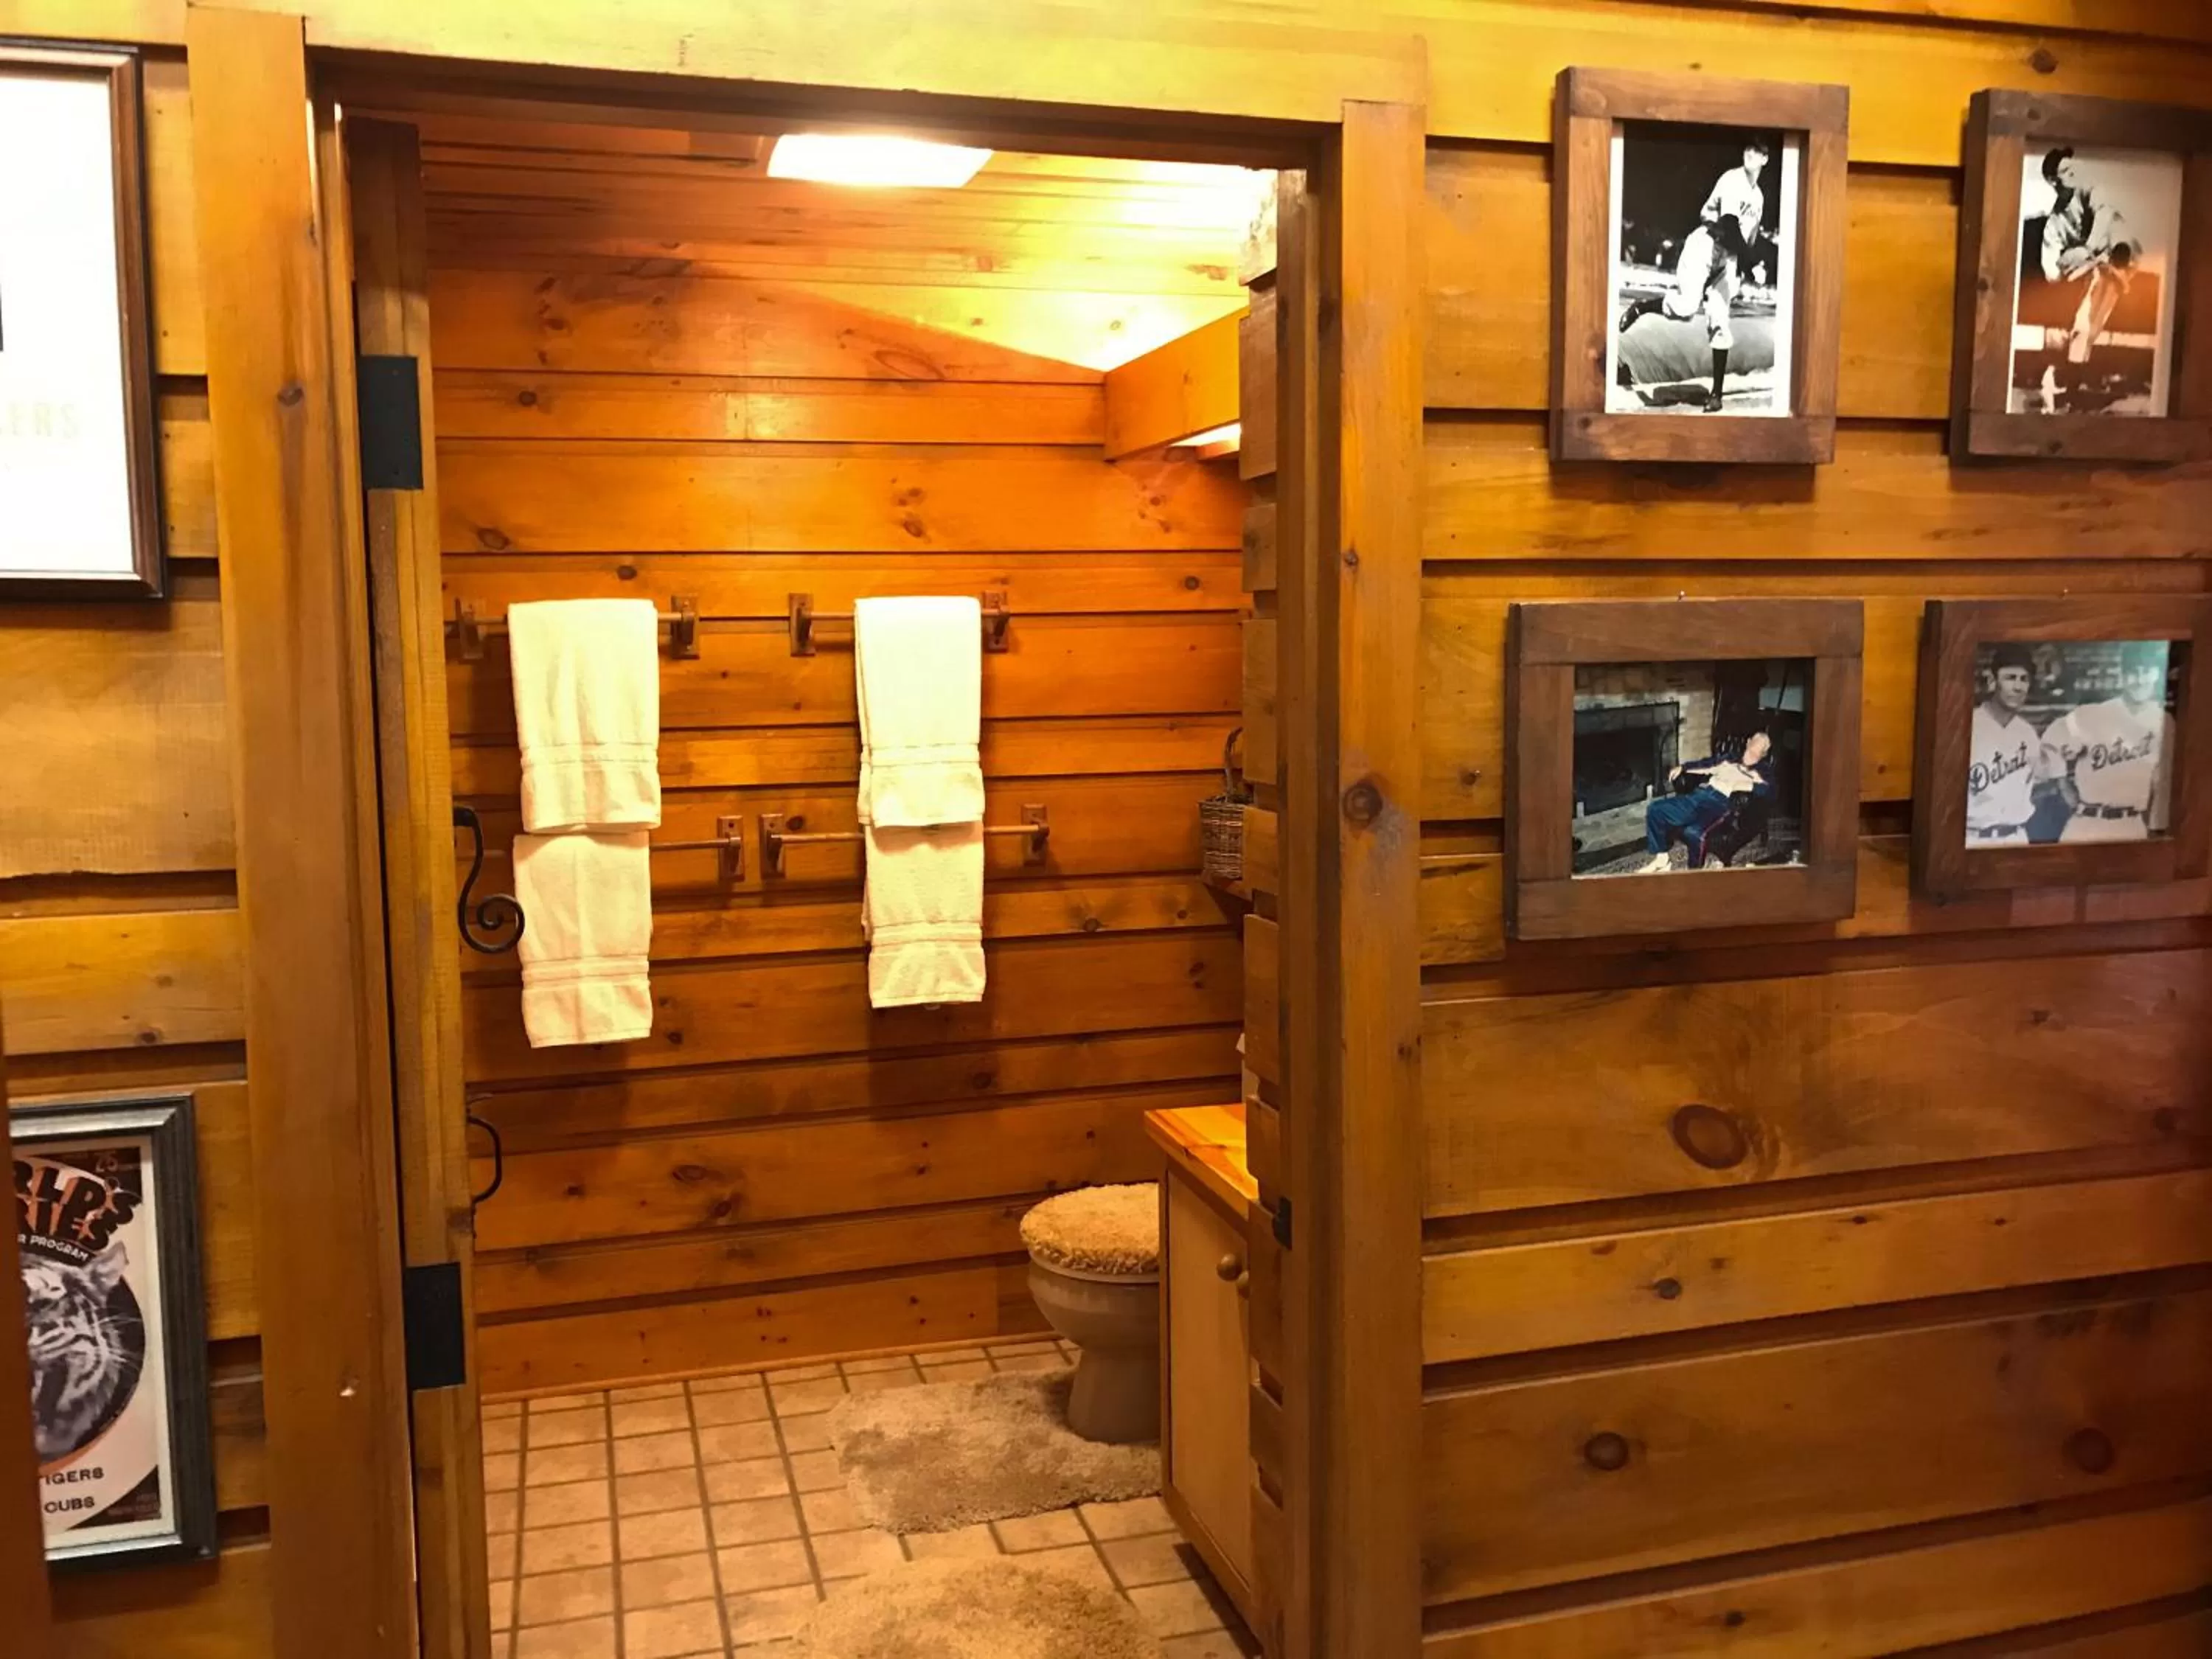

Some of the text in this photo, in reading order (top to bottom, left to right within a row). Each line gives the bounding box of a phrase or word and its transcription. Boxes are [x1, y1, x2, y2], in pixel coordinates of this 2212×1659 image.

[0, 401, 79, 440] ERS
[29, 1234, 89, 1262] PROGRAM
[45, 1467, 105, 1485] IGERS
[44, 1496, 95, 1514] CUBS
